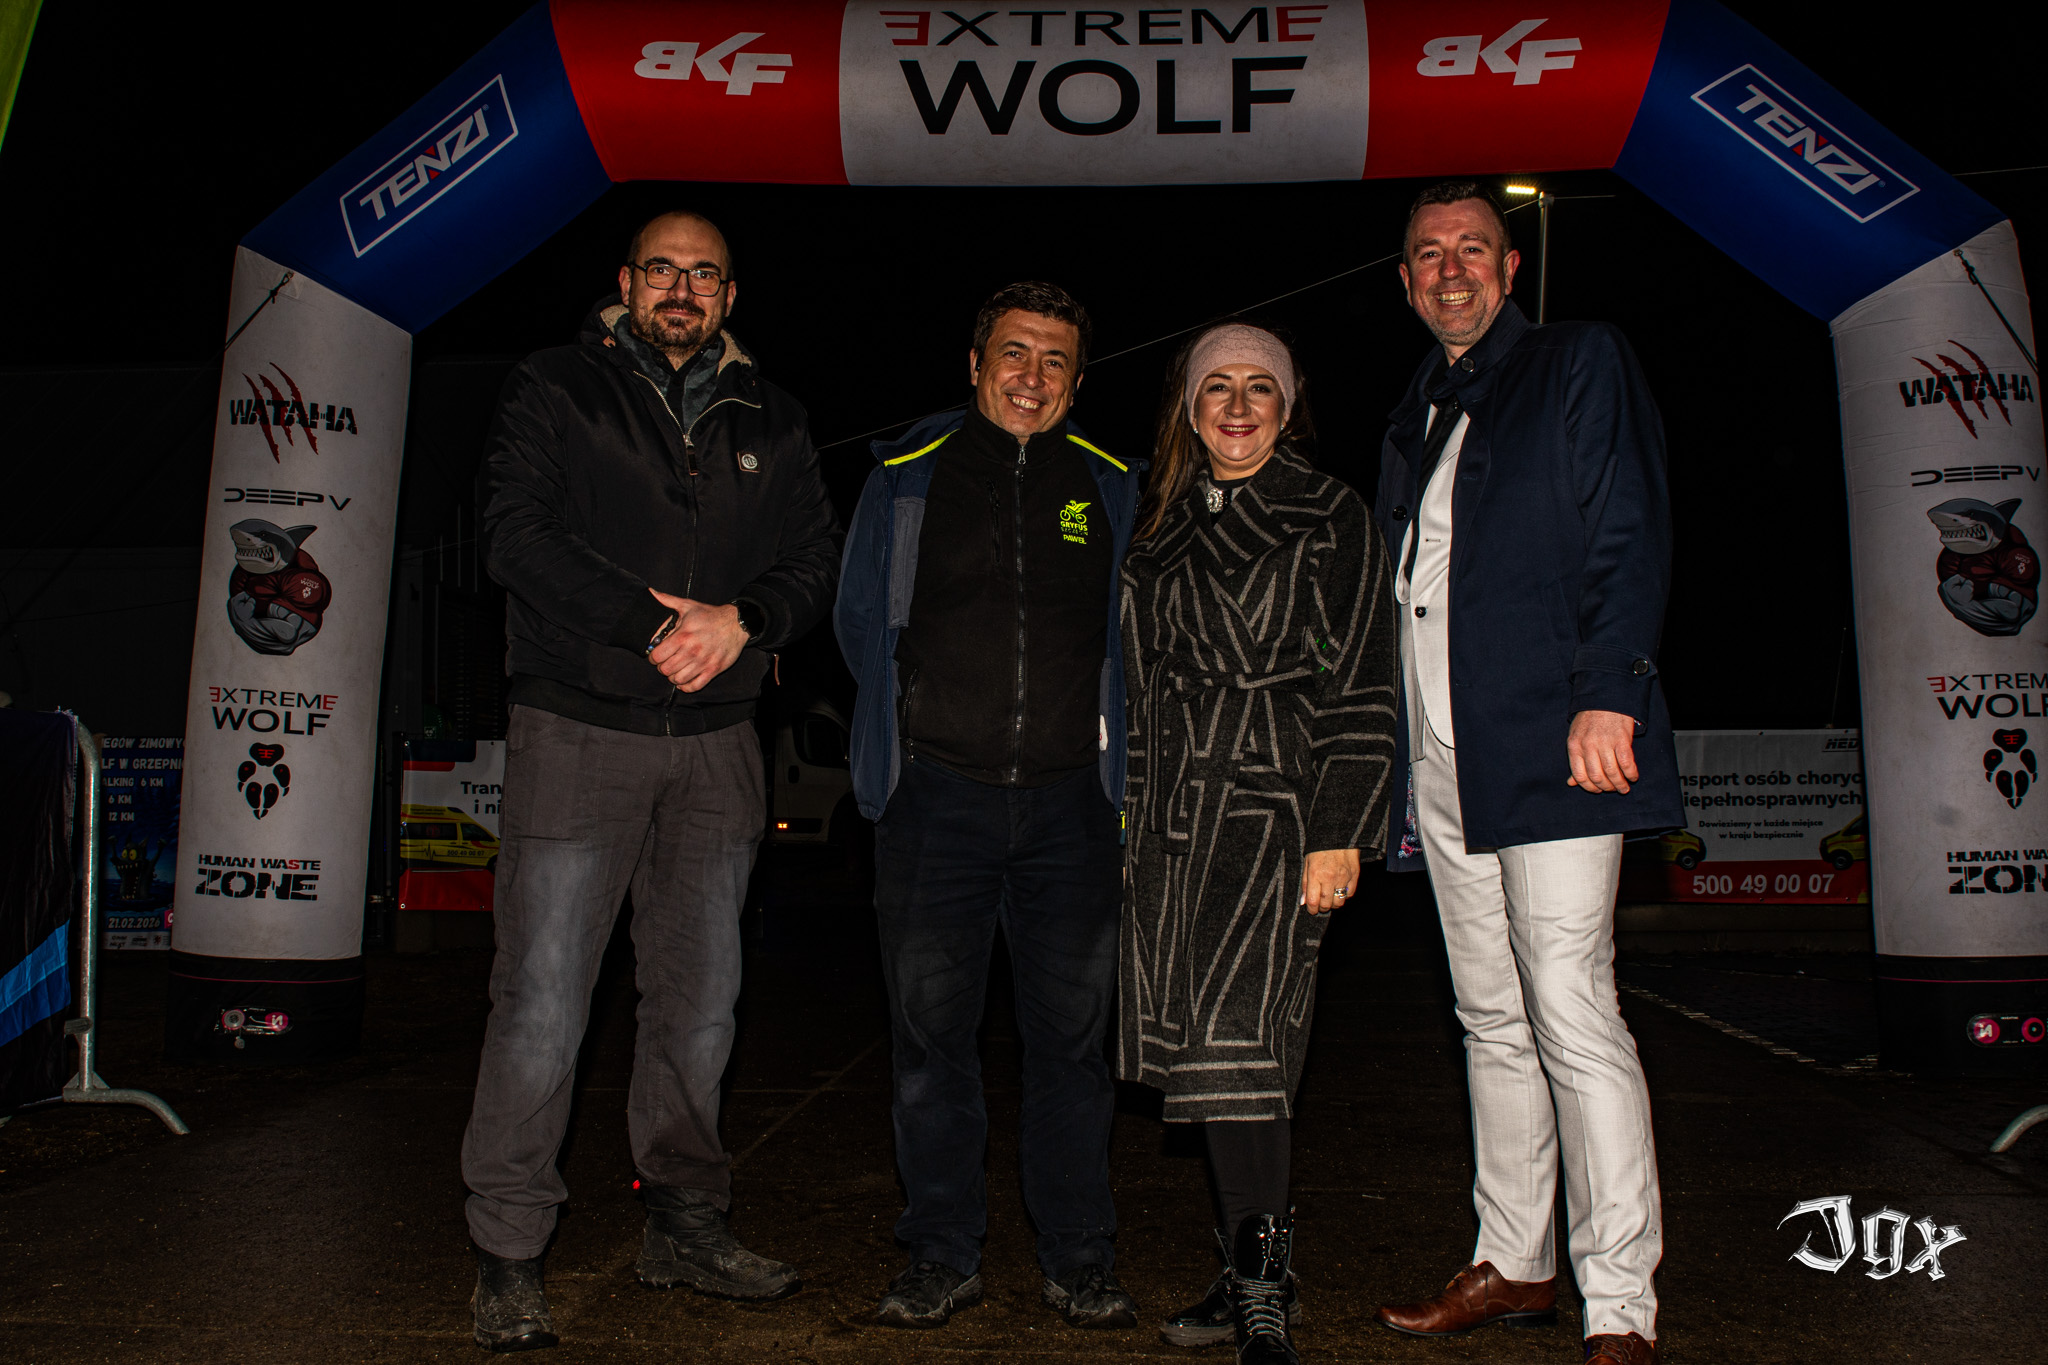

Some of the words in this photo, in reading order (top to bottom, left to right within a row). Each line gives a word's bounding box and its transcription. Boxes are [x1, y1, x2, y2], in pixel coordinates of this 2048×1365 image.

[880, 5, 1328, 46] EXTREME
[899, 56, 1308, 136] WOLF
[1735, 82, 1881, 196] TENZI
[359, 107, 490, 221] TENZI
[1899, 372, 2034, 408] WATAHA
[230, 399, 358, 435] WATAHA
[209, 686, 339, 711] EXTREME
[211, 706, 331, 736] WOLF
[138, 737, 185, 749] ZIMOWY
[132, 757, 183, 770] GRZEPNI
[150, 777, 164, 788] KM
[1744, 771, 1792, 786] osób
[117, 794, 132, 805] KM
[474, 799, 480, 814] i
[120, 811, 135, 822] KM
[1729, 831, 1752, 840] kraju
[1753, 831, 1804, 840] bezpiecznie
[198, 854, 256, 868] HUMAN
[260, 858, 321, 870] WASTE
[1947, 849, 2019, 862] HUMAN
[195, 868, 320, 901] ZONE
[1692, 875, 1733, 895] 500
[1740, 875, 1768, 894] 49
[1774, 874, 1801, 894] 00
[1808, 873, 1836, 894] 07
[107, 916, 161, 929] 21.02.2026
